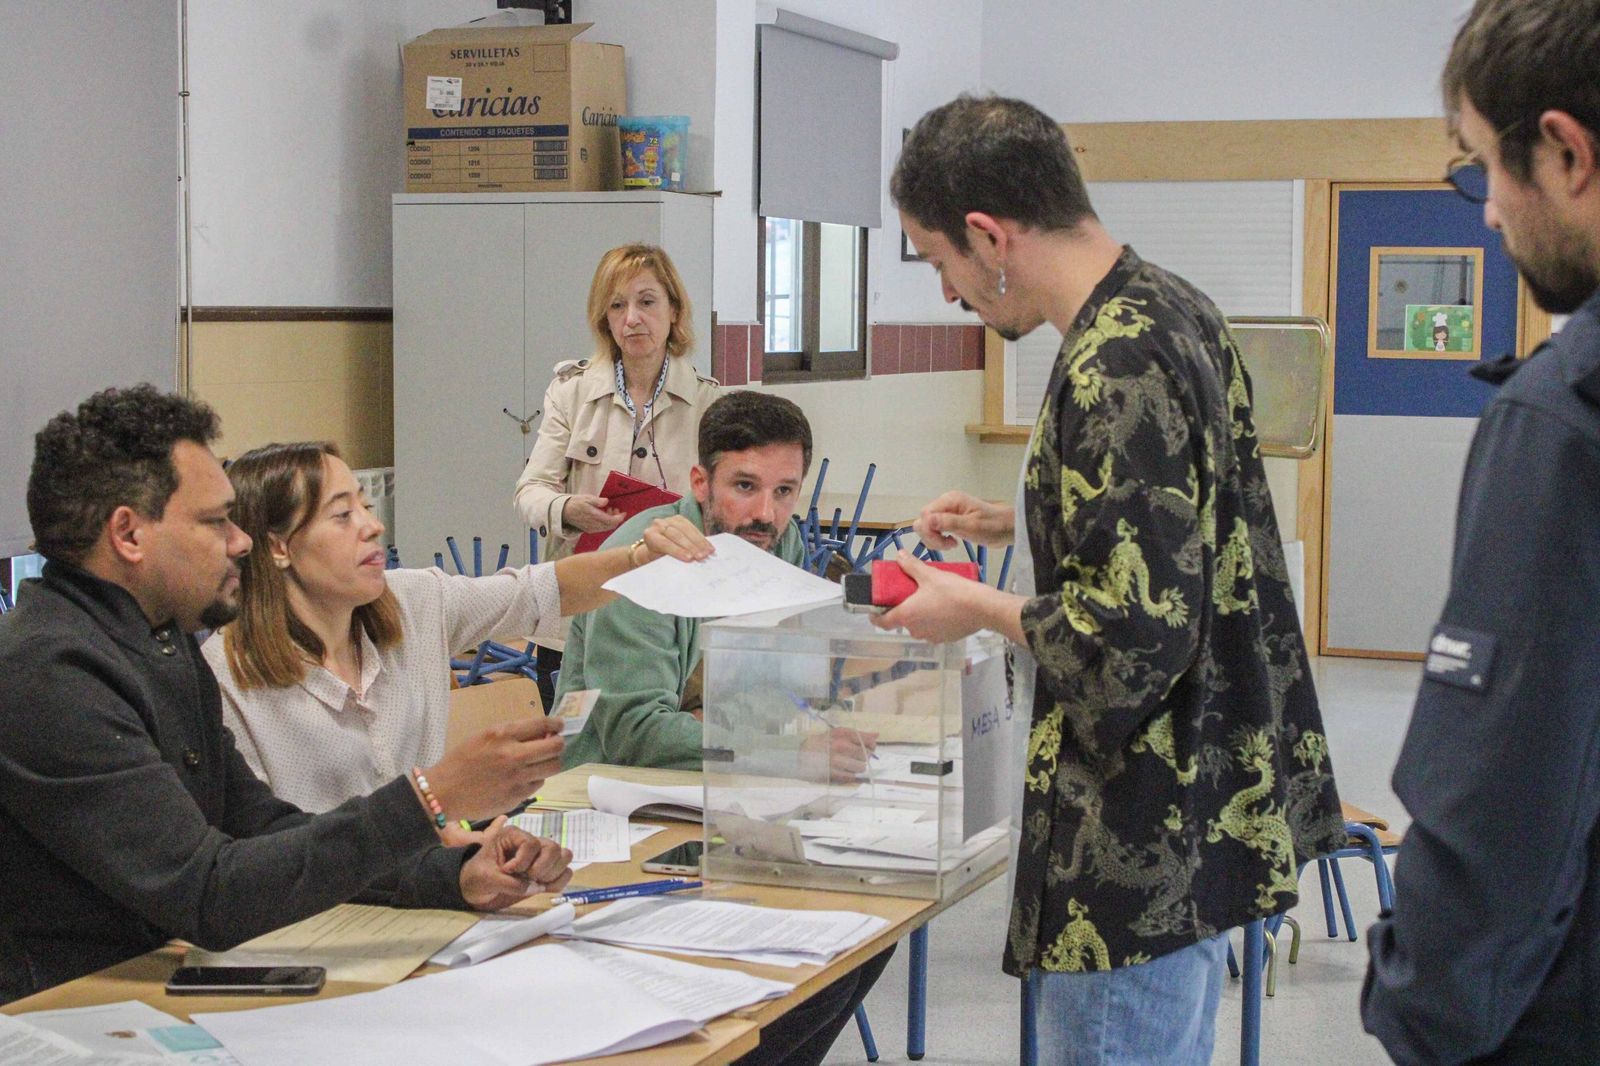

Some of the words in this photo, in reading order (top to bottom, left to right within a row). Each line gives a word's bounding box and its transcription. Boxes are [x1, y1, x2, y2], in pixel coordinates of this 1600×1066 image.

[450, 47, 520, 60] SERVILLETAS
[582, 106, 621, 127] Caricia
[440, 128, 482, 137] CONTENIDO
[497, 127, 536, 136] PAQUETES
[971, 706, 1000, 741] MESA
